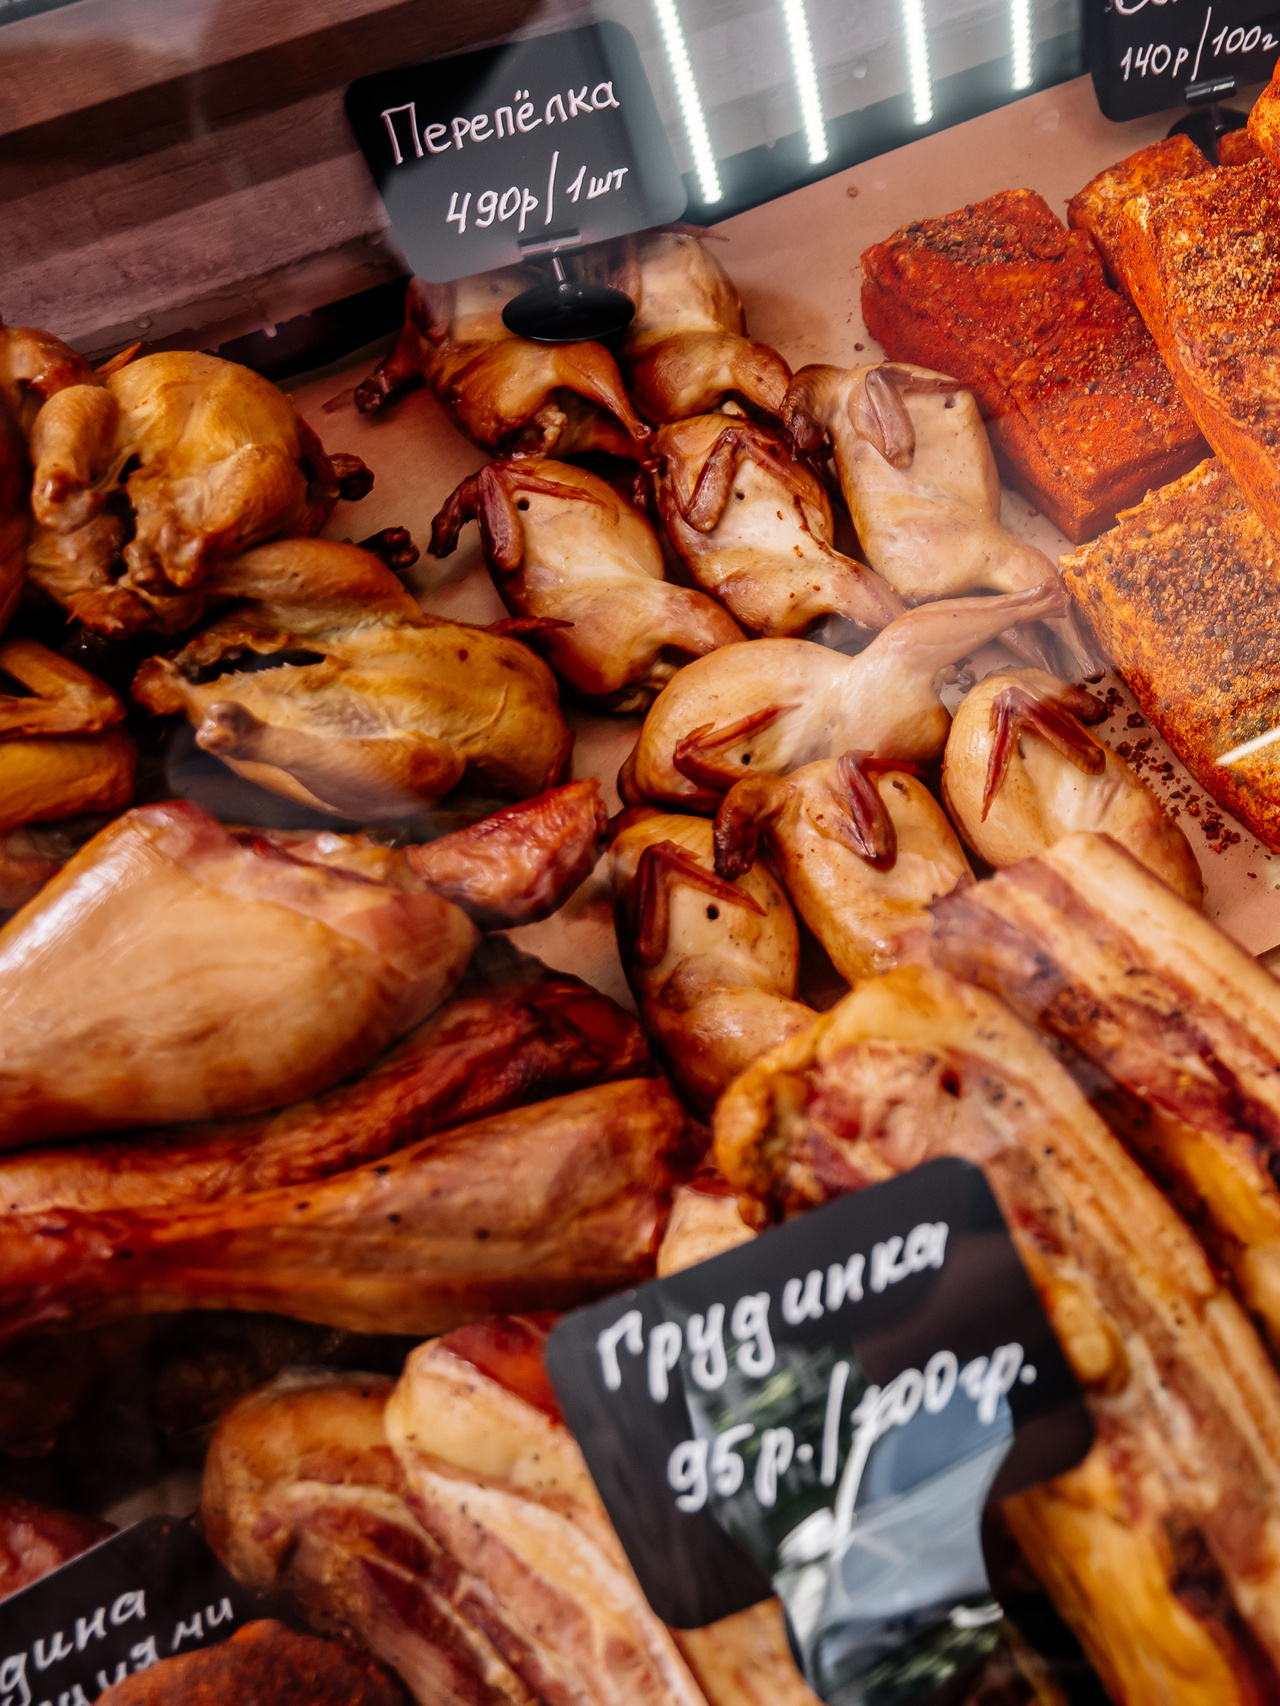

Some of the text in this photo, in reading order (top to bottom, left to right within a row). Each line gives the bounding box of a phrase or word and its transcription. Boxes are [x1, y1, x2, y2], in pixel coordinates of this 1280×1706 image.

[380, 80, 620, 165] Перепёлка
[446, 150, 629, 234] 490р/1шт
[597, 1220, 950, 1403] Грудинка
[666, 1342, 1039, 1514] 95р./100гр.
